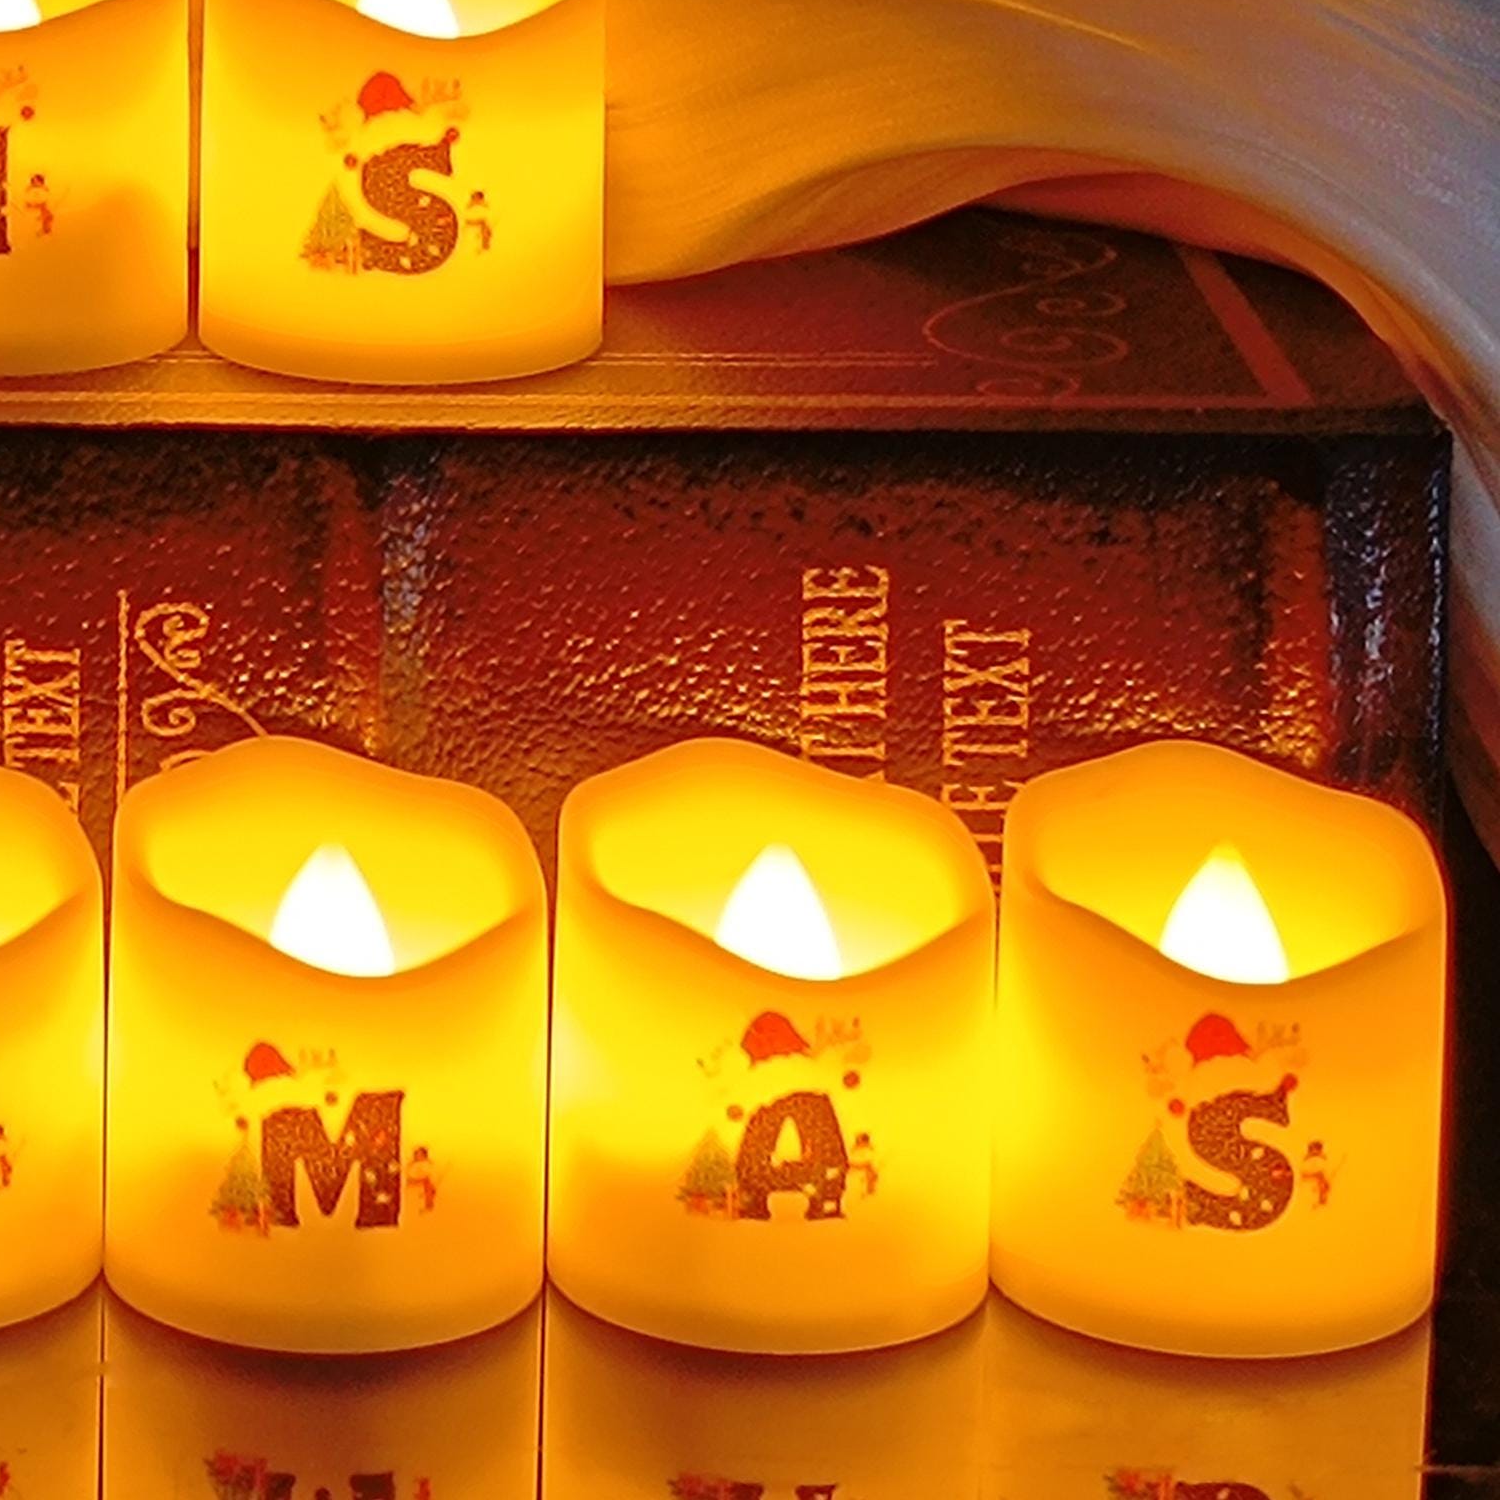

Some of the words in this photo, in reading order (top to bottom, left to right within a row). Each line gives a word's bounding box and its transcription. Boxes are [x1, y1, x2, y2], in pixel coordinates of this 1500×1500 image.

[356, 140, 460, 276] S
[2, 638, 81, 768] TEXT
[943, 619, 1032, 766] TEXT
[259, 1088, 405, 1228] M
[735, 1090, 848, 1221] A
[1184, 1088, 1296, 1231] S
